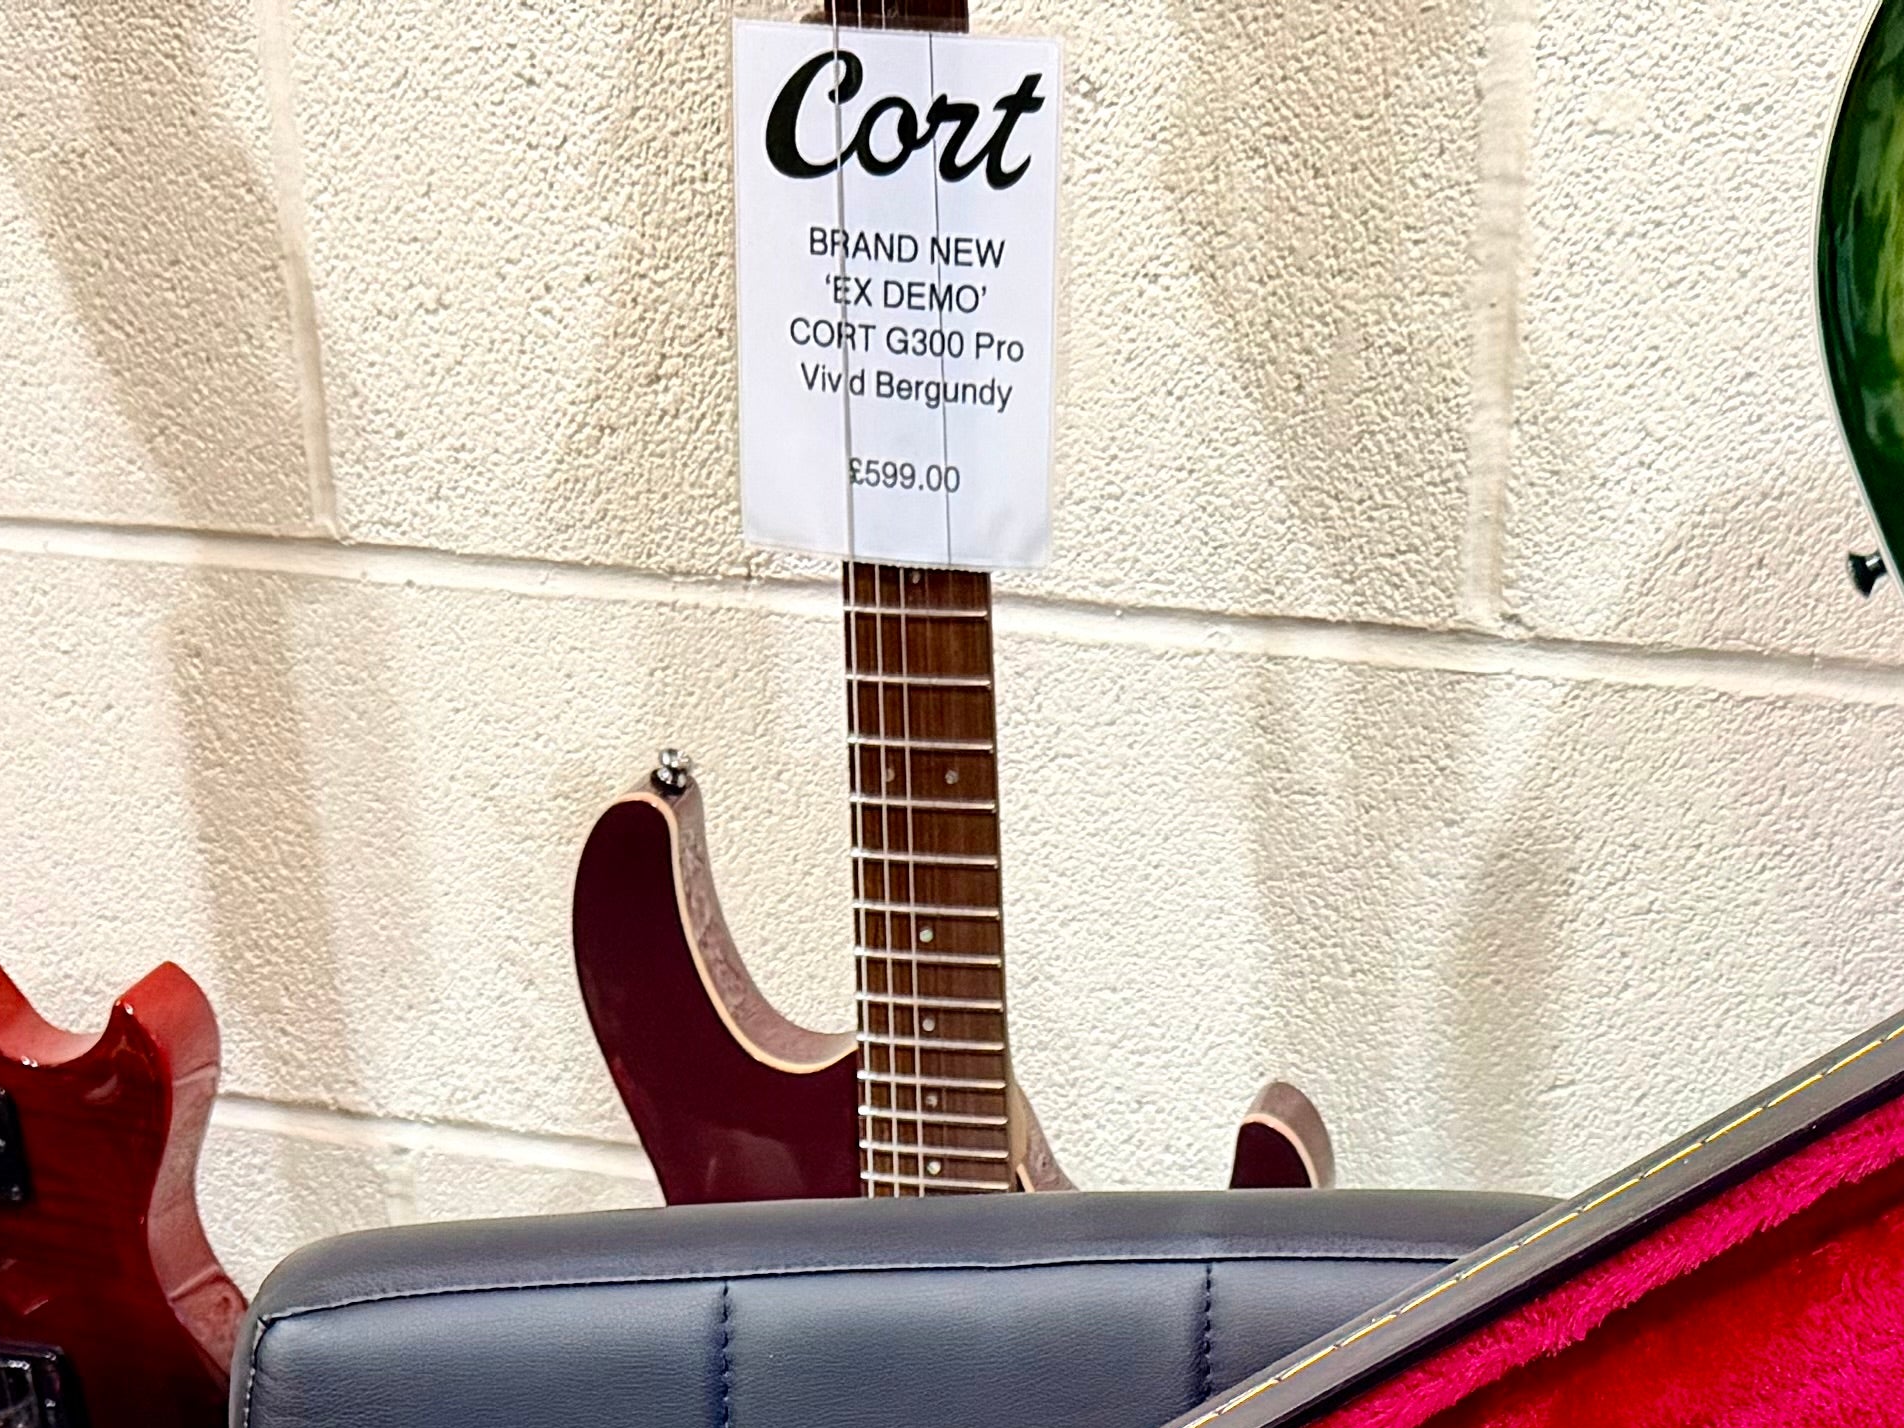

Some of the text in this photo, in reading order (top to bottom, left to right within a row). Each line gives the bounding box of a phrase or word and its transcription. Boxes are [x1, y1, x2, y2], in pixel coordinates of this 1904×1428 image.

[765, 49, 1046, 190] Cort
[809, 226, 1006, 269] BRAND NEW
[790, 317, 1025, 363] CORT G300 Pro
[800, 361, 1013, 413] Vivd Bergundy
[848, 458, 961, 493] £599.00
